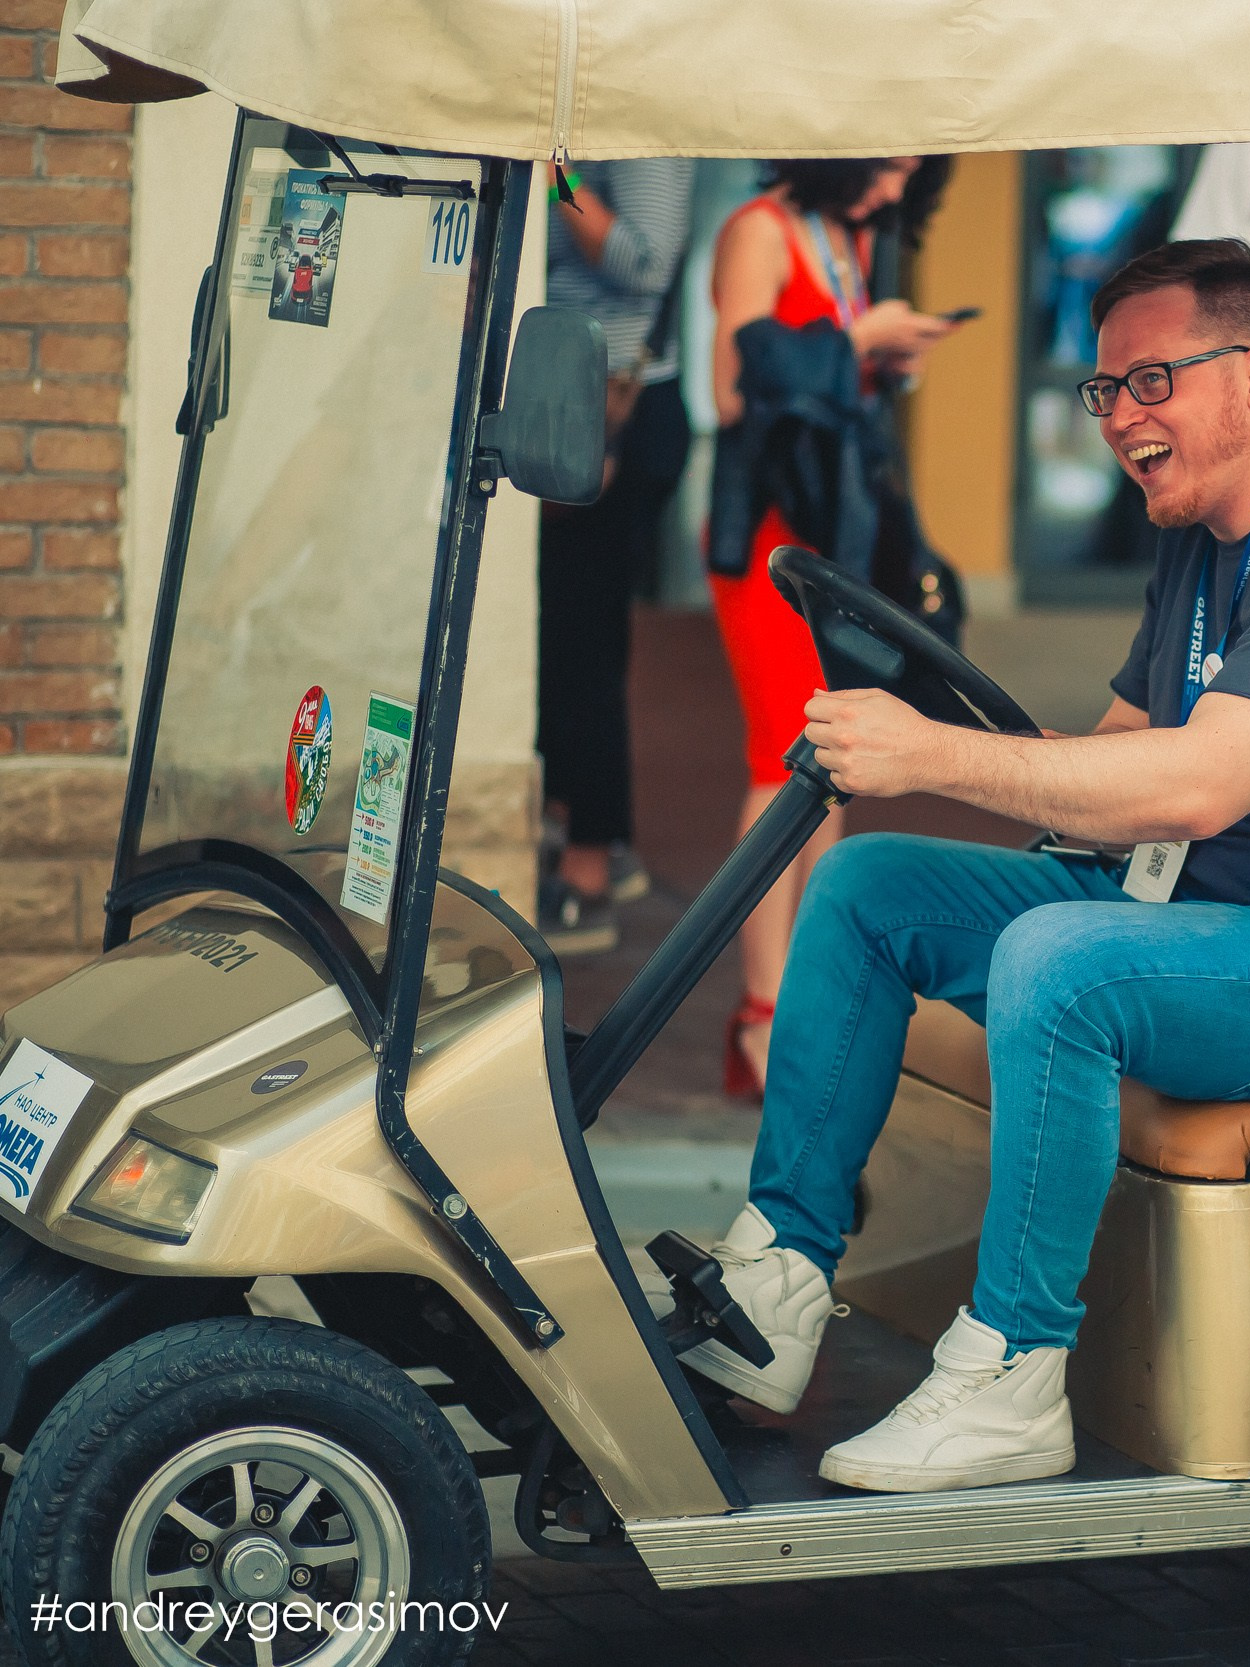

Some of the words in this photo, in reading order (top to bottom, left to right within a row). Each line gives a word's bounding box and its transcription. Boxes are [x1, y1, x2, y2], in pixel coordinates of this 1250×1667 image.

[432, 201, 470, 266] 110
[1187, 596, 1205, 684] GASTREET
[297, 701, 308, 736] 9
[14, 1092, 33, 1114] НАО
[30, 1103, 58, 1128] ЦЕНТР
[0, 1112, 45, 1176] ОМЕГА
